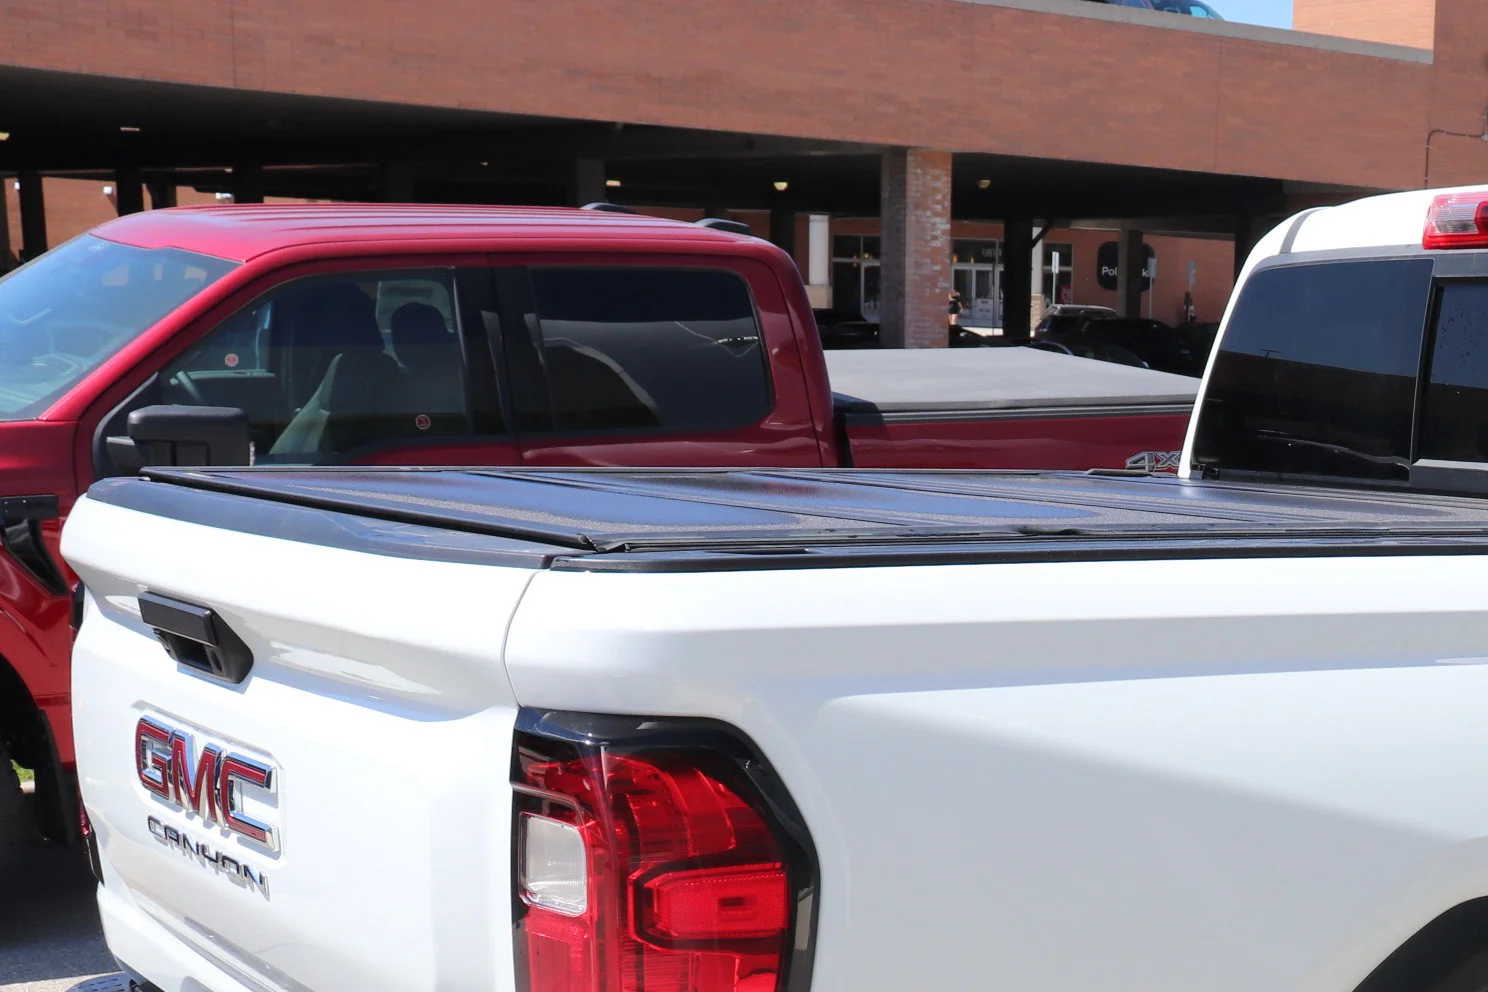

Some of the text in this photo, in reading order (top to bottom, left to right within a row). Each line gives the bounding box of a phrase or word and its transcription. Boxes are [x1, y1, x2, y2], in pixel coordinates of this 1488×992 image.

[1125, 450, 1182, 473] 4X
[135, 715, 277, 849] GMC
[147, 815, 269, 888] CANYON
